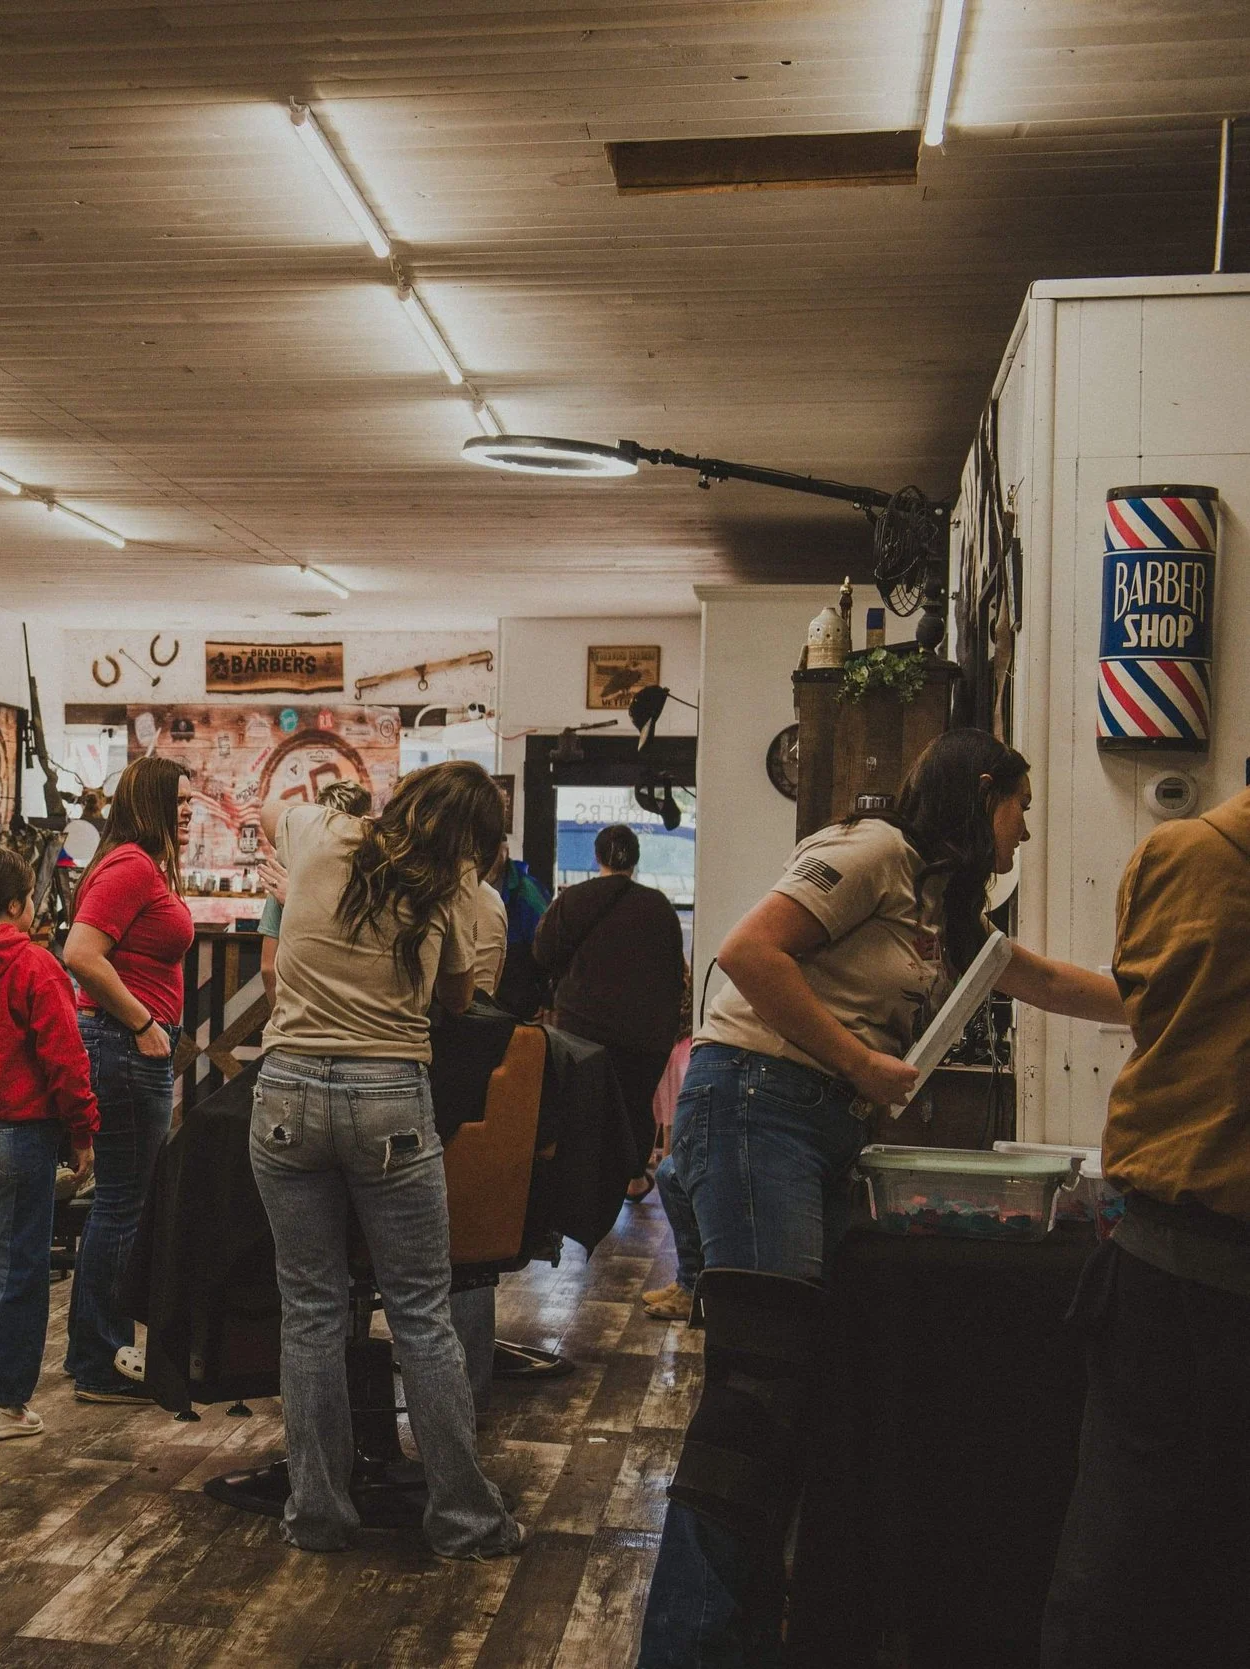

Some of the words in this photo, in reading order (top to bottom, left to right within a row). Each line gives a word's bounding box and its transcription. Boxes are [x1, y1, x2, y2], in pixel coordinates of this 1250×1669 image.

[1113, 561, 1206, 624] BARBER
[1123, 614, 1194, 648] SHOP
[231, 655, 317, 675] BARBERS
[251, 648, 297, 657] BRANDED
